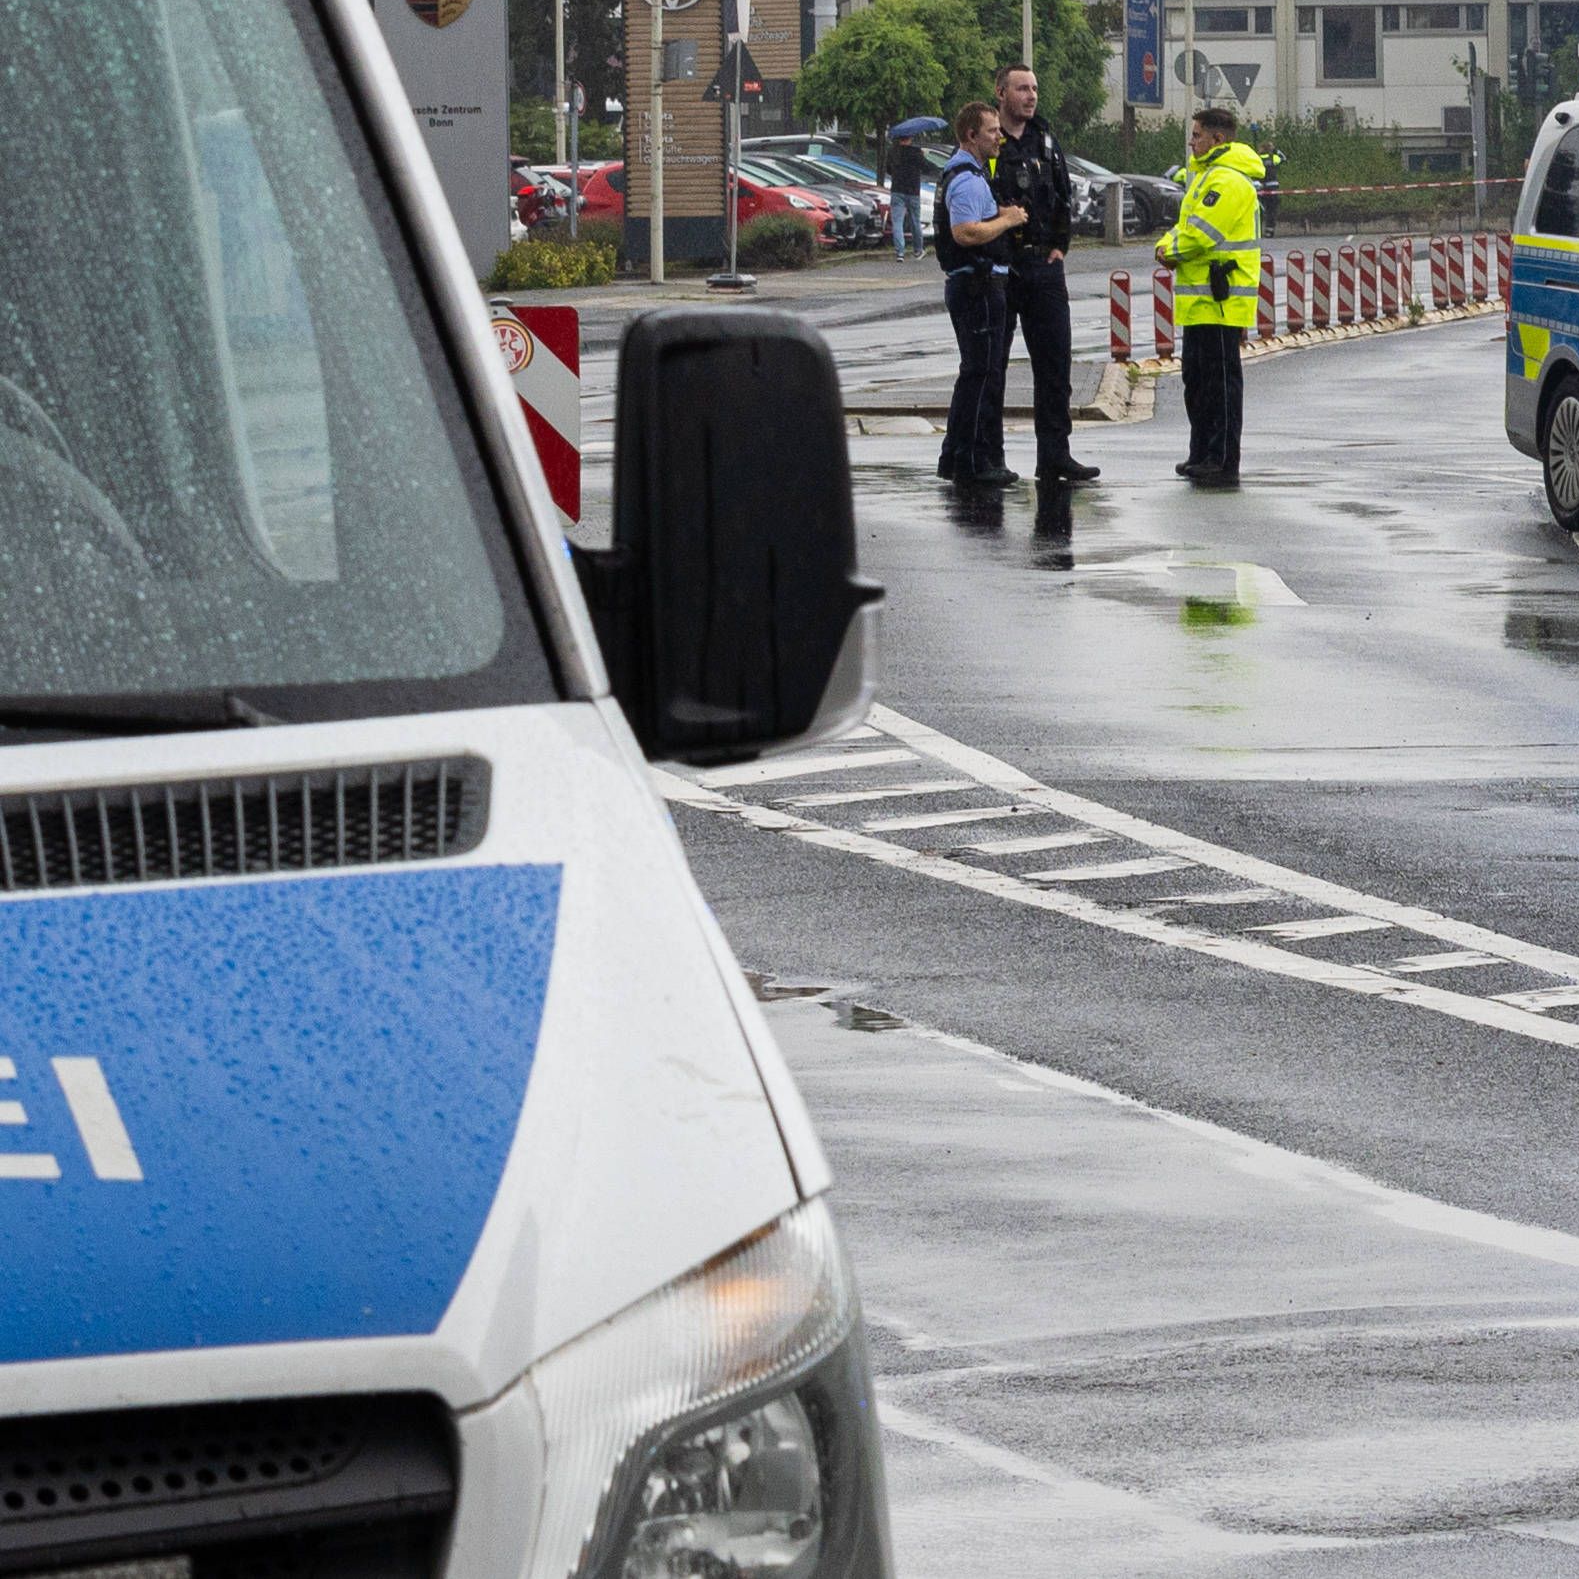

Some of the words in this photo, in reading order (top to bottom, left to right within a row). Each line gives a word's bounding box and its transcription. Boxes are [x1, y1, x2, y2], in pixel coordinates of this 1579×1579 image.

[411, 105, 438, 115] rsche
[441, 105, 482, 115] Zentrum
[428, 117, 454, 128] Bonn
